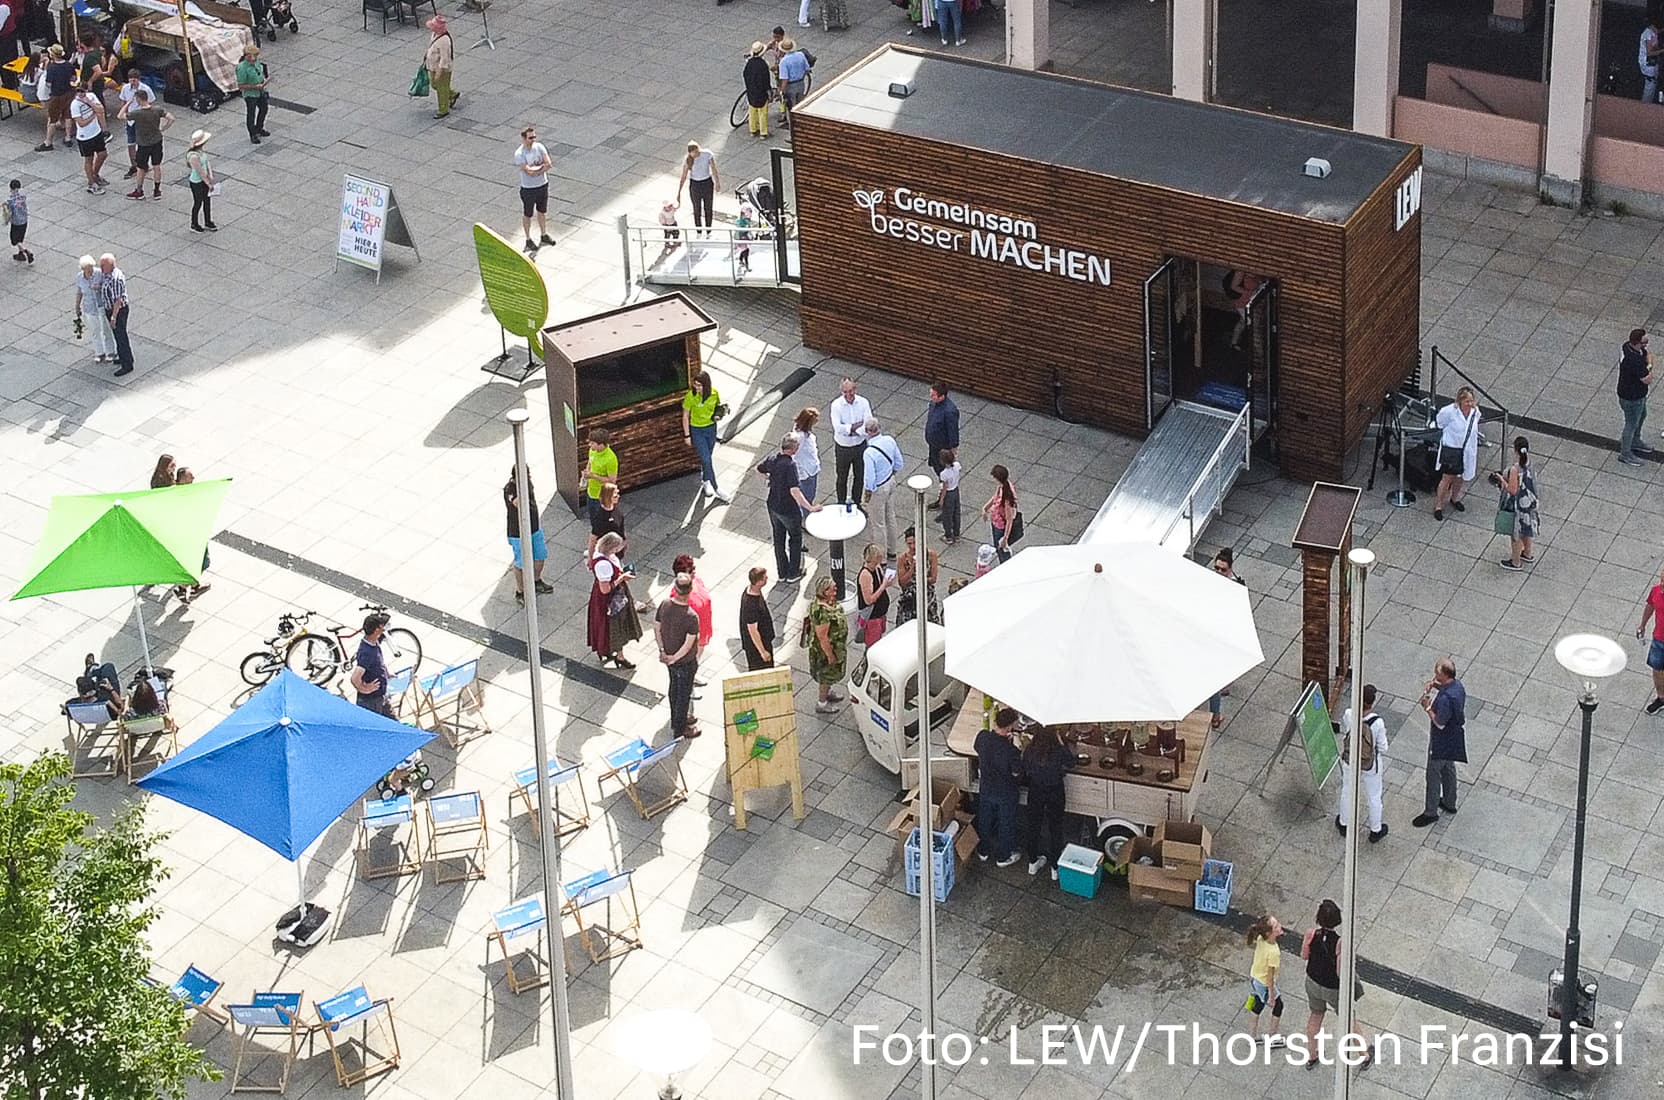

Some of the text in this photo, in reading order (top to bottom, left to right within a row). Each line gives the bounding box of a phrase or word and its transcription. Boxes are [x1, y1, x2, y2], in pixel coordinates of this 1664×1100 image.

[346, 181, 380, 198] SECOND
[357, 196, 384, 208] HAND
[1396, 165, 1423, 232] LEW
[343, 202, 382, 228] KLEIDER
[894, 187, 1037, 240] Gemeinsam
[342, 219, 375, 236] MARKT
[354, 236, 372, 248] HIER
[871, 203, 1112, 287] besser MACHEN
[353, 244, 377, 258] HEUTE
[831, 557, 843, 570] EW
